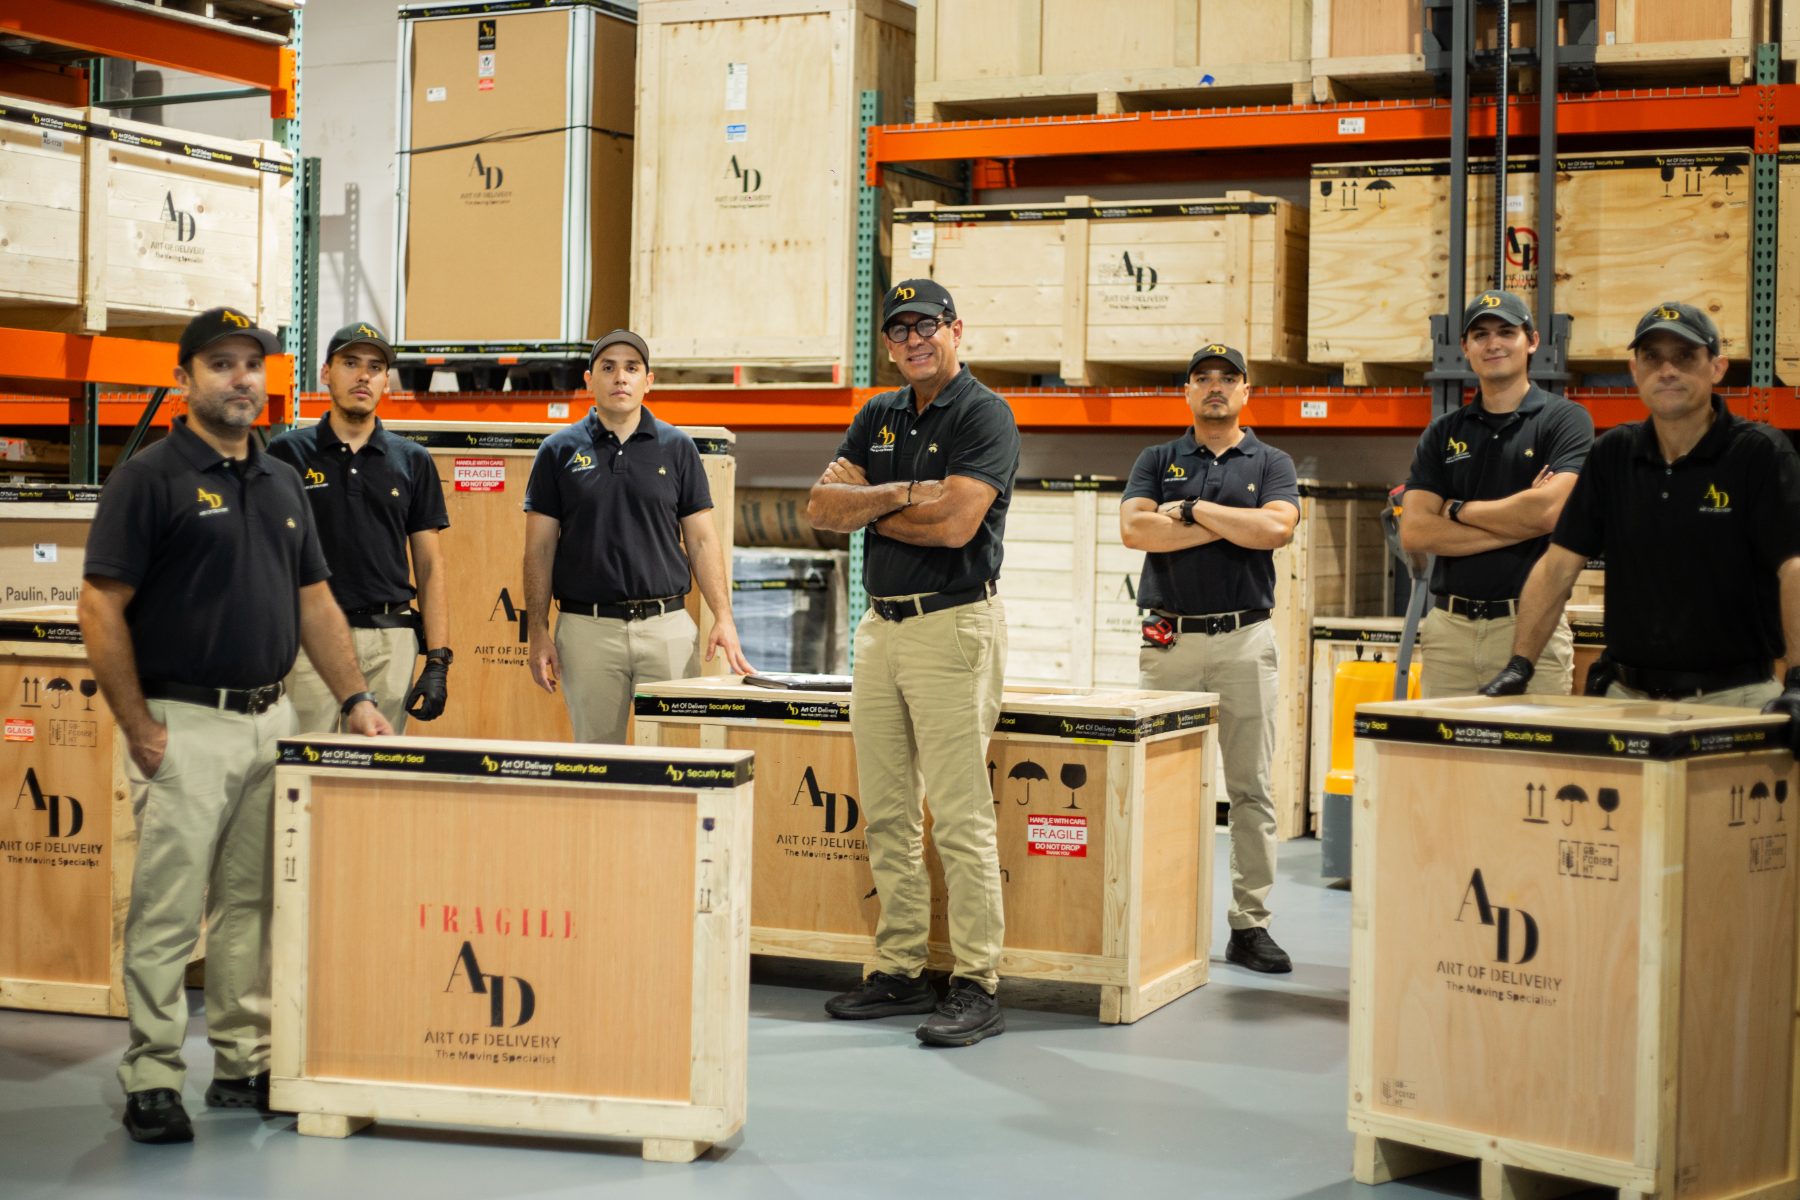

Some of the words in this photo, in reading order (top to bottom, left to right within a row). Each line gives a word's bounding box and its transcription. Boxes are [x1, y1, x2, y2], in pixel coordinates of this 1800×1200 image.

[468, 153, 503, 190] AD
[724, 155, 762, 193] AD
[160, 190, 196, 242] AD
[1115, 251, 1158, 292] AD
[894, 286, 916, 300] AD
[1480, 294, 1500, 308] AD
[223, 310, 250, 328] AD
[1653, 305, 1679, 320] AD
[357, 323, 378, 338] AD
[1206, 344, 1227, 355] AD
[877, 425, 895, 445] AD
[1447, 437, 1468, 454] AD
[573, 452, 591, 467] AD
[305, 467, 325, 484] AD
[458, 469, 502, 478] FRAGILE
[1167, 463, 1185, 478] AD
[197, 487, 222, 508] AD
[1703, 484, 1729, 508] AD
[6, 587, 47, 603] Paulin,
[51, 587, 79, 601] Pauli
[1577, 630, 1599, 639] Security
[474, 646, 495, 655] ART
[498, 646, 512, 656] OF
[498, 658, 525, 667] Moving
[658, 700, 669, 712] AD
[688, 703, 708, 712] Delivery
[709, 704, 731, 712] Security
[786, 703, 799, 716] AD
[818, 707, 839, 717] Delivery
[7, 727, 32, 735] GLASS
[1060, 719, 1073, 733] AD
[1085, 724, 1094, 732] Of
[1095, 725, 1116, 735] Delivery
[1371, 721, 1388, 730] Seal
[1438, 723, 1453, 740] AD
[1477, 729, 1503, 740] Delivery
[1504, 731, 1534, 742] Security
[1535, 733, 1553, 742] Seal
[1609, 734, 1625, 752] AD
[303, 746, 319, 762] AD
[345, 752, 373, 762] Delivery
[374, 753, 404, 764] Security
[407, 755, 425, 763] Seal
[481, 755, 498, 772] AD
[501, 760, 512, 768] Art
[513, 760, 524, 769] Of
[525, 761, 553, 772] Delivery
[555, 763, 587, 774] Security
[588, 765, 607, 774] Seal
[666, 764, 684, 781] AD
[687, 769, 720, 779] Security
[13, 767, 84, 838] AD
[790, 766, 859, 833] AD
[776, 835, 799, 845] ART
[802, 836, 817, 846] OF
[1032, 828, 1084, 841] FRAGILE
[0, 841, 22, 852] ART
[25, 841, 42, 852] OF
[44, 842, 103, 855] DELIVERY
[784, 848, 799, 857] The
[802, 851, 831, 860] Moving
[833, 852, 870, 862] Specialis
[8, 855, 22, 864] The
[25, 856, 56, 867] Moving
[1454, 868, 1539, 964] AD
[1436, 960, 1464, 976] ART
[1468, 965, 1486, 979] OF
[1491, 969, 1562, 991] DELIVERY
[443, 940, 536, 1028] AD
[1446, 981, 1464, 992] The
[1467, 984, 1504, 1001] Moving
[1506, 991, 1557, 1007] Specialist
[424, 1030, 454, 1044] ART
[459, 1032, 479, 1046] OF
[484, 1034, 561, 1048] DELIVERY
[436, 1049, 455, 1060] The
[459, 1051, 499, 1063] Moving
[502, 1052, 556, 1064] Specialist
